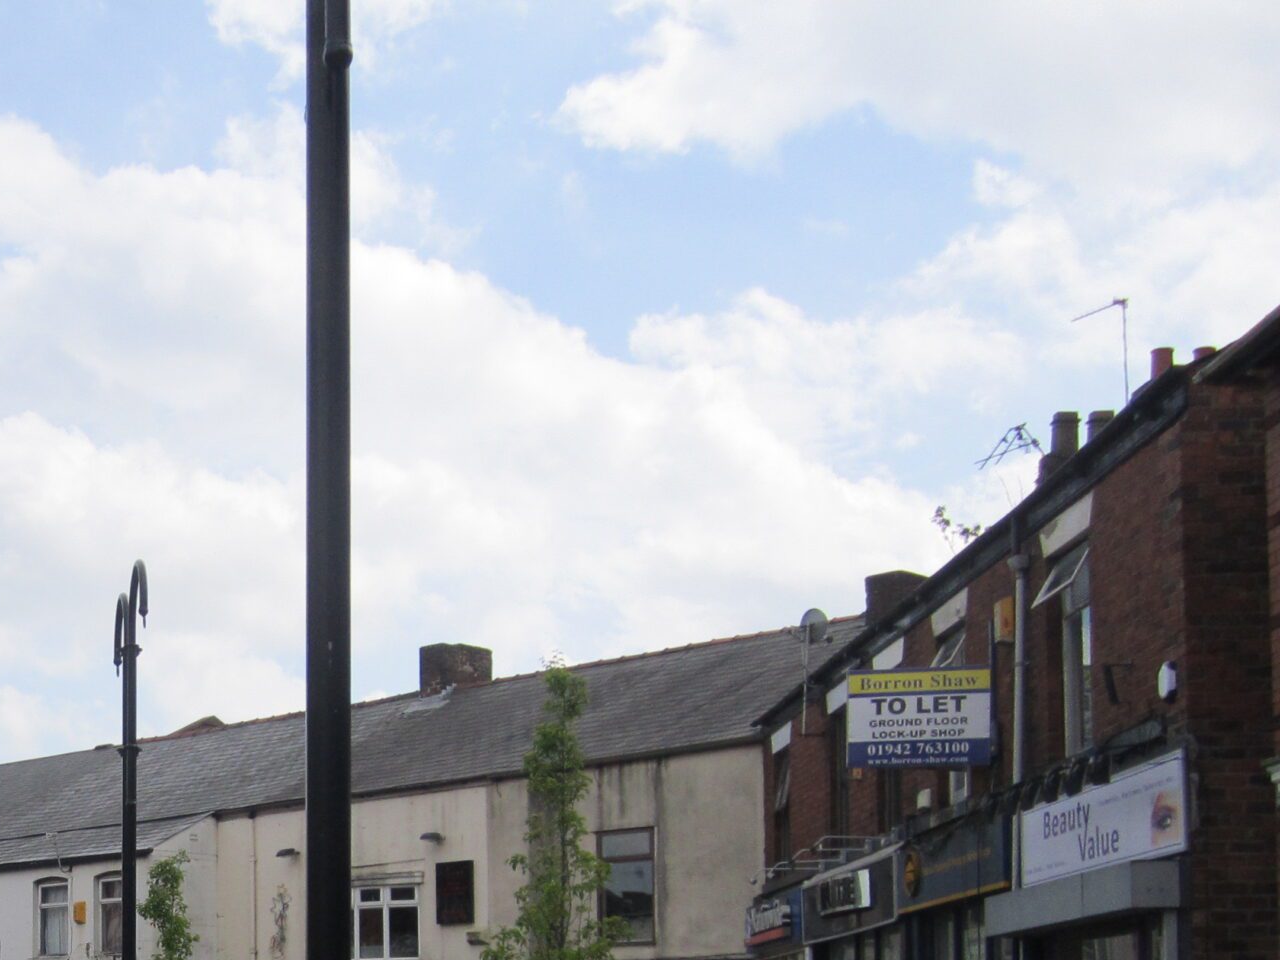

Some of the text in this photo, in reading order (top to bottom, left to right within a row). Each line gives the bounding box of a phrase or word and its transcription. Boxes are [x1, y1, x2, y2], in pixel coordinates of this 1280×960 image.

[860, 674, 978, 691] Borron Shaw
[870, 695, 967, 715] TO LET
[869, 716, 969, 728] GROUND FLOOR
[871, 729, 966, 739] LOCK-UP SHOP
[867, 741, 969, 756] 01942 763100
[1043, 802, 1091, 840] Beauty
[1078, 826, 1120, 862] Value
